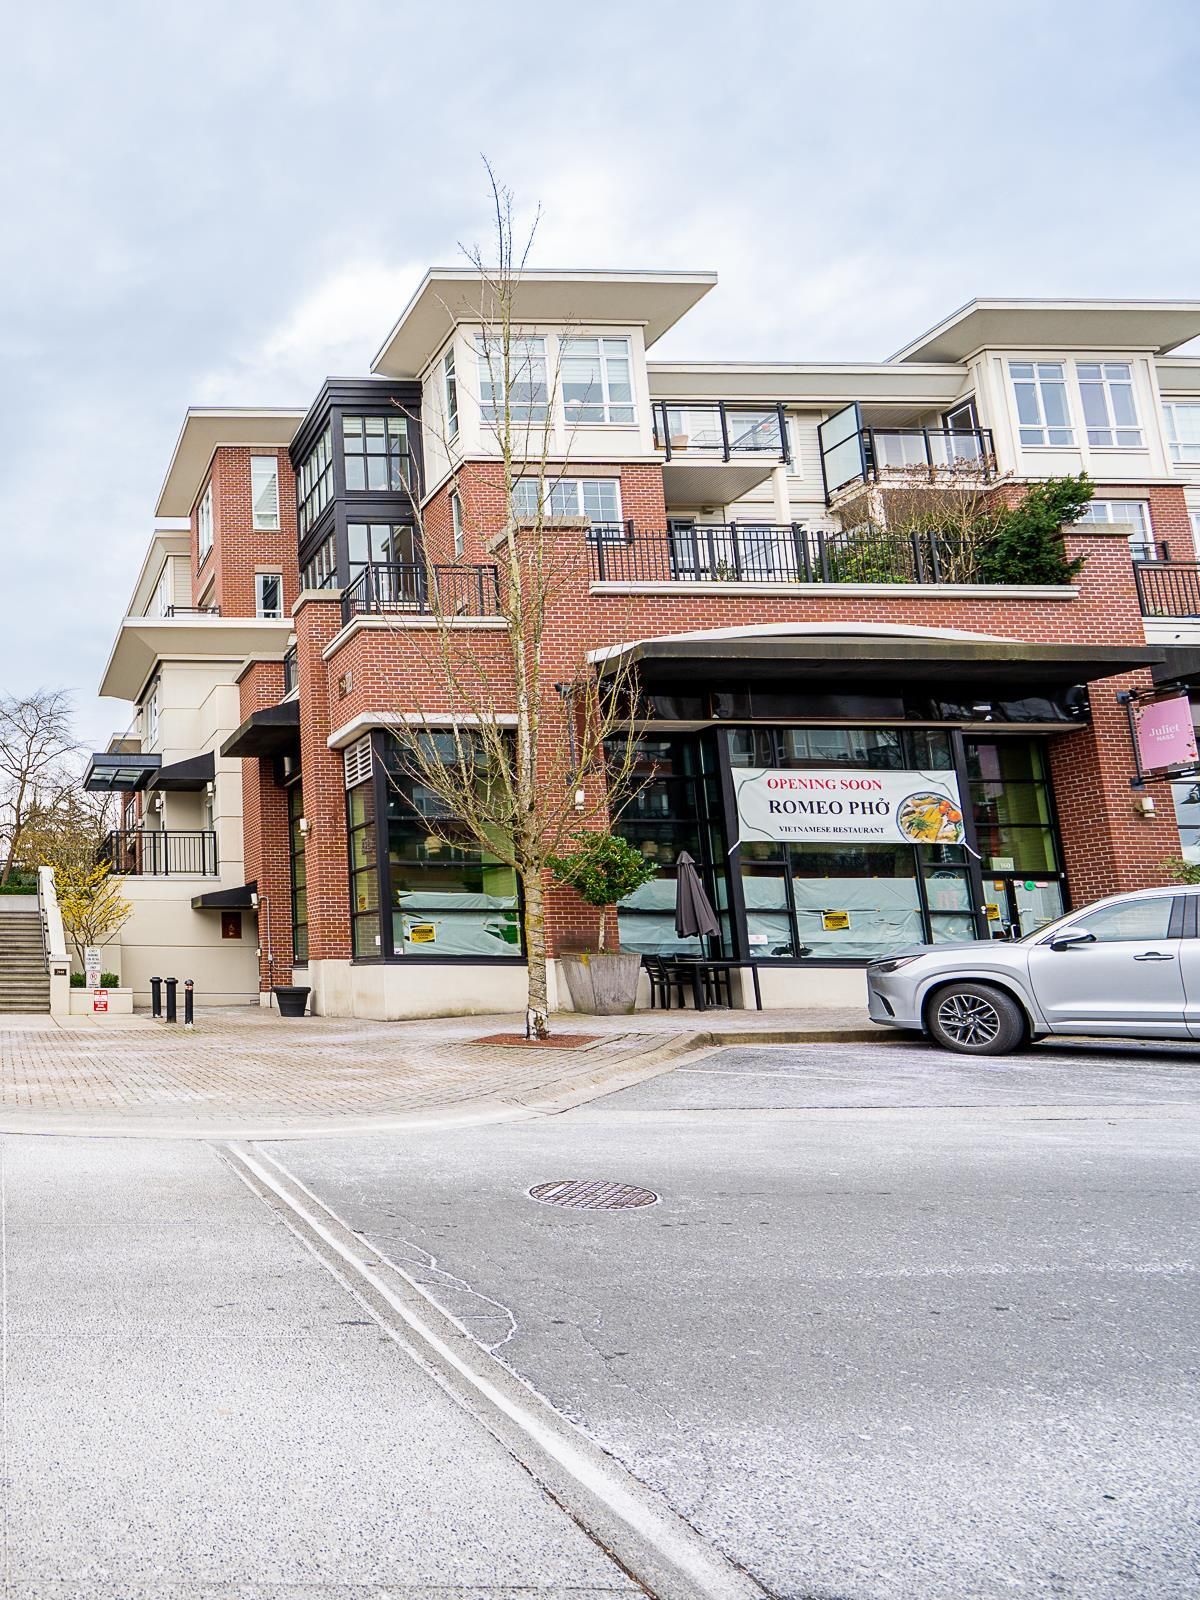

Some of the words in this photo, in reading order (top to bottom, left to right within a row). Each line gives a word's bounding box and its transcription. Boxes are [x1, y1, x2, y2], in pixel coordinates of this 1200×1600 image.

[1149, 724, 1180, 736] Juliet
[767, 778, 837, 790] OPENING
[841, 779, 882, 791] SOON
[769, 800, 843, 815] ROMEO
[833, 826, 884, 834] RESTAURANT
